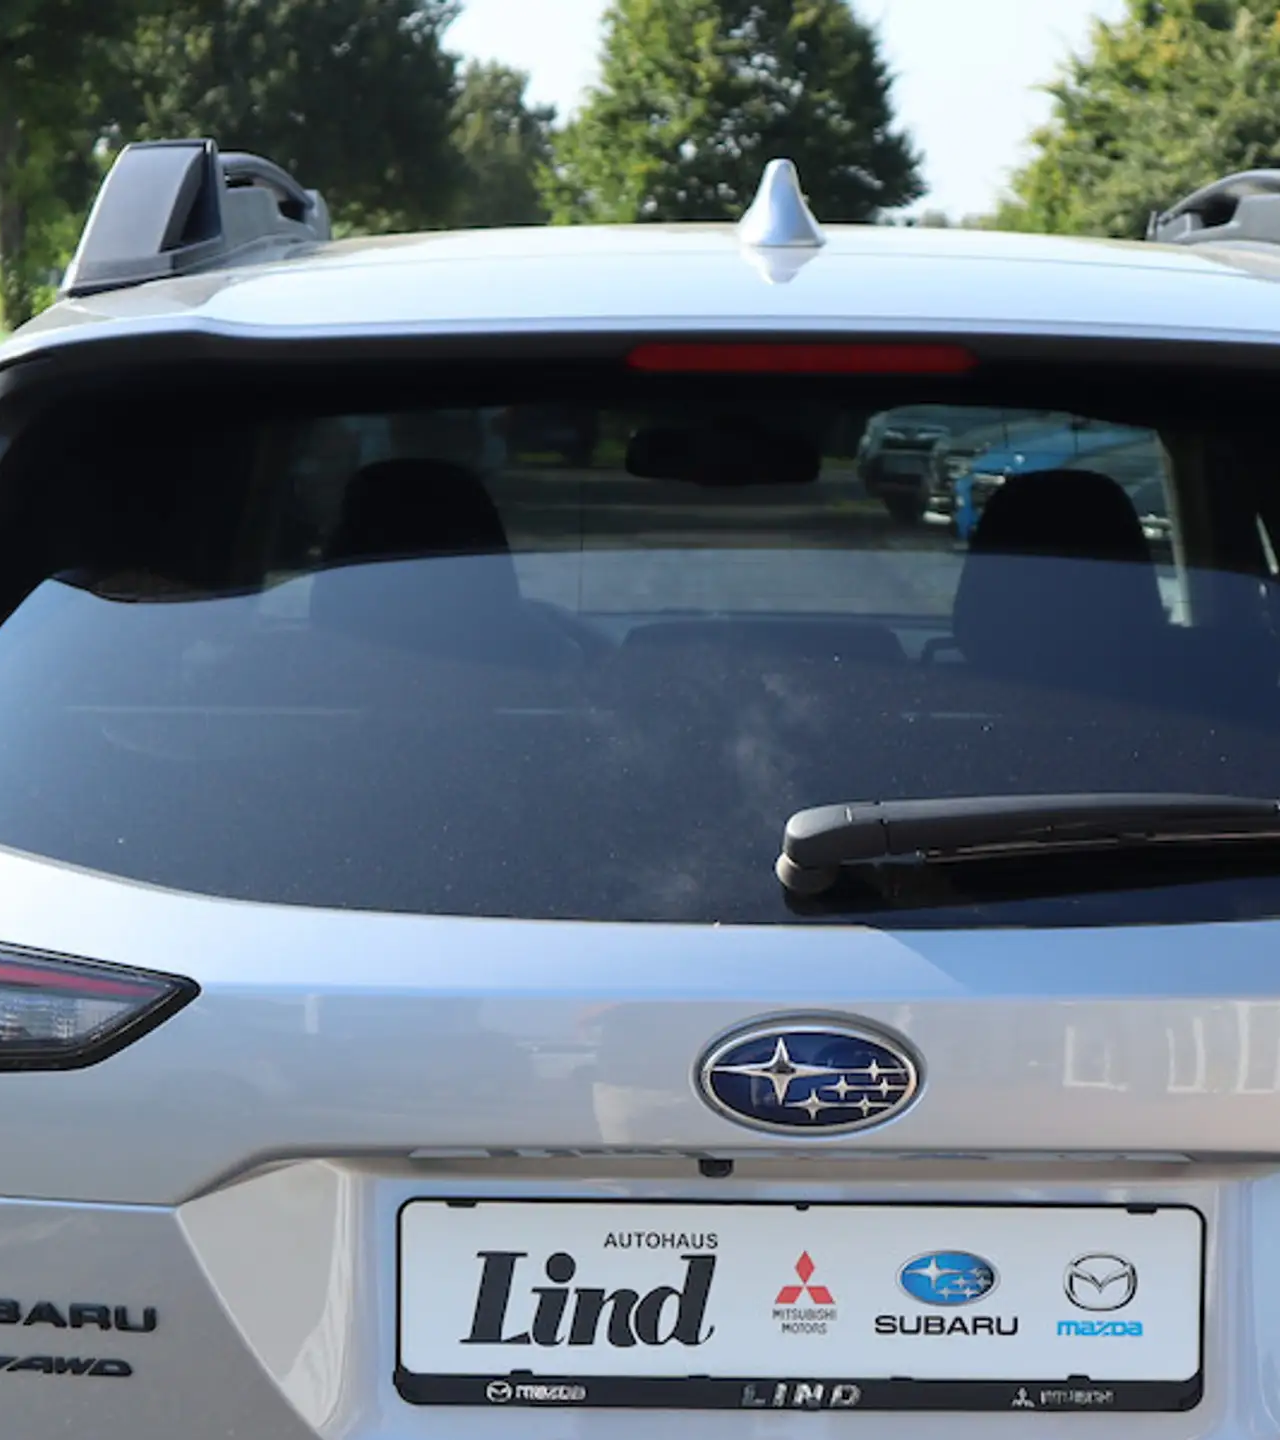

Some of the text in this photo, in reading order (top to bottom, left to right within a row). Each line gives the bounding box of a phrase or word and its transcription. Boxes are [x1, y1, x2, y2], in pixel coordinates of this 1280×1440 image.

[603, 1232, 719, 1250] AUTOHAUS
[459, 1251, 717, 1347] Lind
[772, 1308, 838, 1322] MITSUBISHI
[781, 1322, 828, 1335] MOTORS
[874, 1315, 1020, 1336] SUBARU
[1056, 1320, 1144, 1338] mazda
[6, 1356, 134, 1378] AWD
[741, 1383, 862, 1407] LIND
